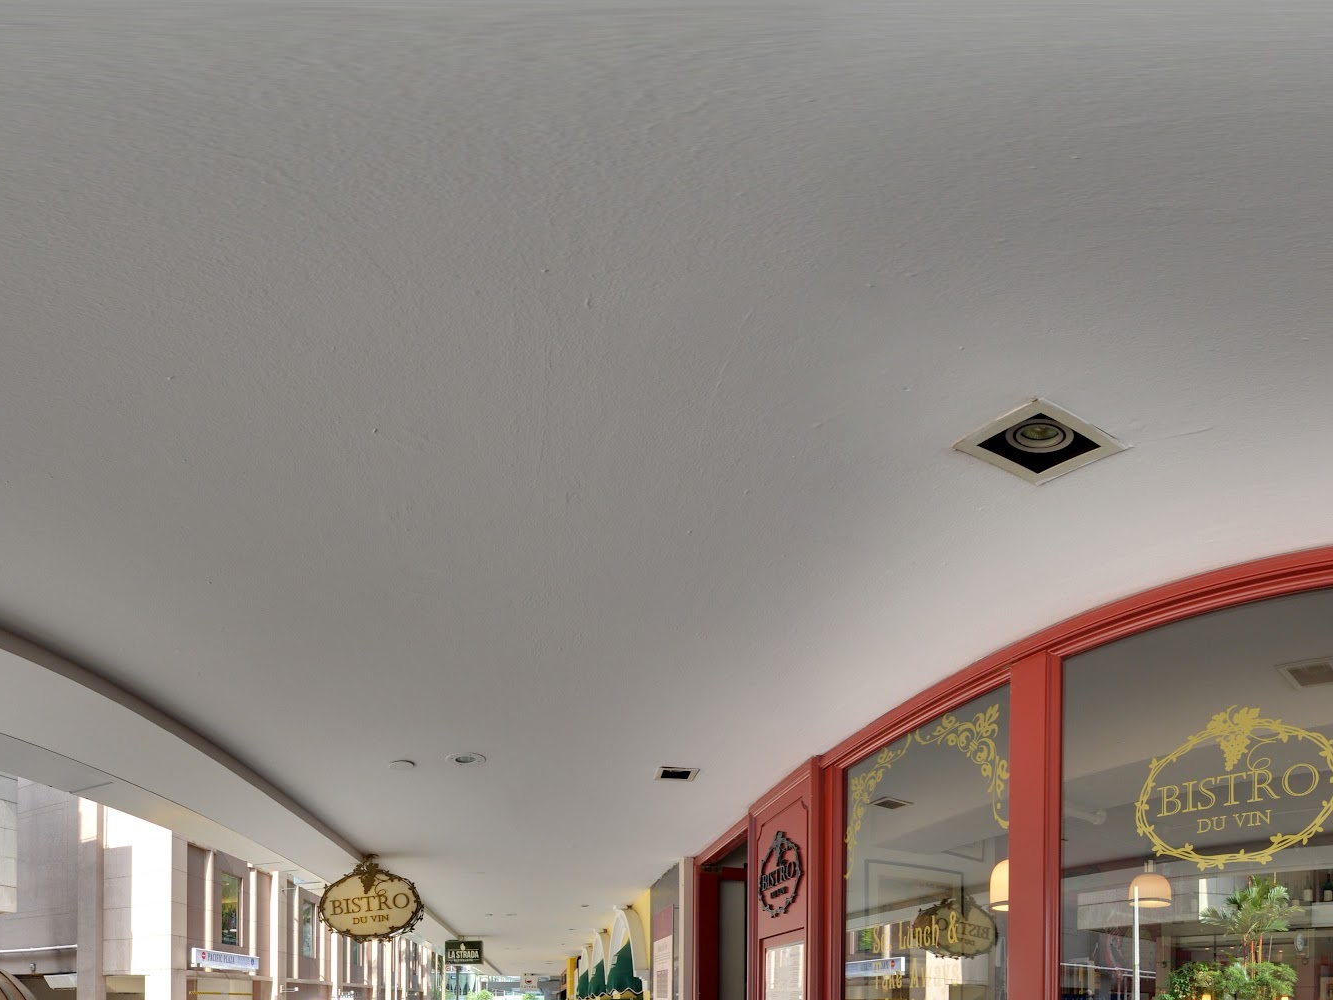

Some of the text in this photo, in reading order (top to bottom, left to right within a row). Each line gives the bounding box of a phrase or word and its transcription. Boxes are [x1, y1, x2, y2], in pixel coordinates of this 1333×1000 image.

[1157, 763, 1319, 817] BISTRO
[1197, 810, 1272, 834] DU VIN
[761, 861, 797, 891] BISTRO
[329, 892, 410, 916] BISTRO
[352, 914, 389, 925] DU VIN
[898, 915, 939, 950] Lunch
[947, 911, 959, 943] &
[447, 950, 479, 959] LA STRADA
